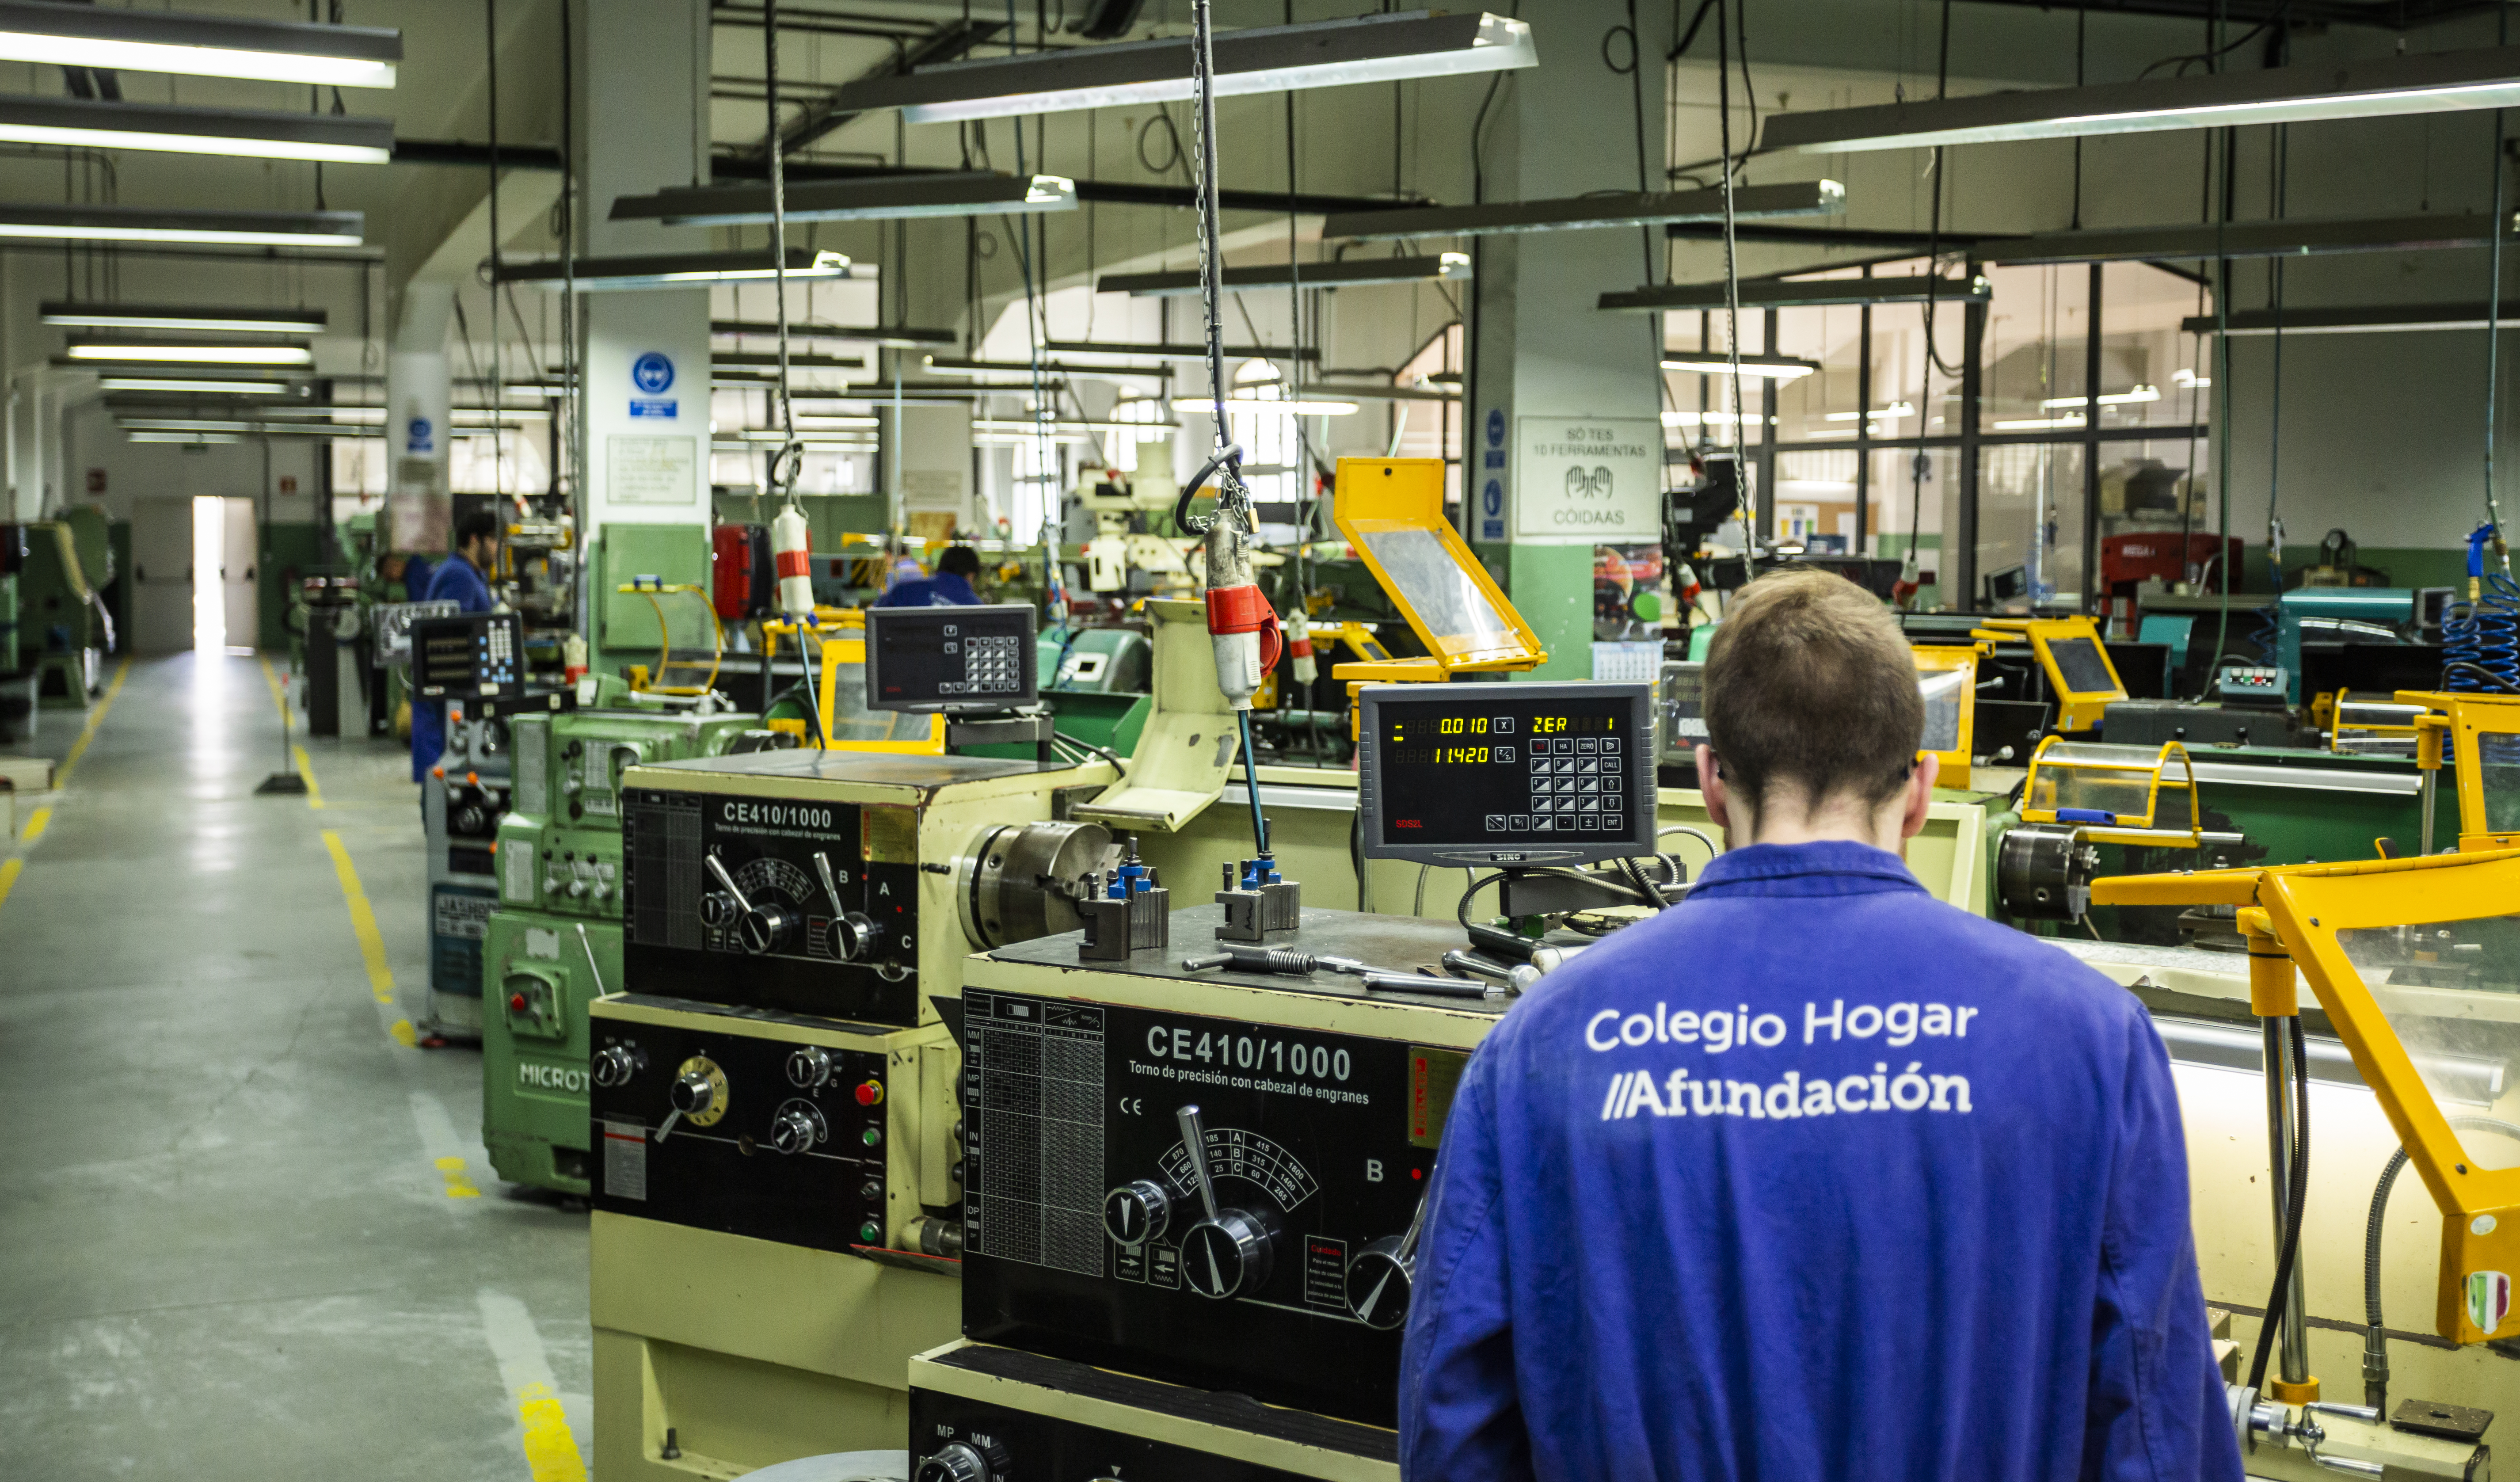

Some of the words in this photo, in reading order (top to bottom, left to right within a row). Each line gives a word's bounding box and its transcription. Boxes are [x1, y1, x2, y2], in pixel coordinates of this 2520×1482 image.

[1591, 428, 1614, 441] TES
[1534, 445, 1547, 456] 10
[1550, 444, 1647, 457] FERRAMENTAS
[1533, 717, 1567, 733] ZER
[1608, 717, 1613, 730] 1
[724, 801, 832, 829] CE410/1000
[839, 870, 849, 884] B
[879, 882, 890, 896] A
[902, 935, 912, 949] C
[1585, 1001, 1787, 1053] Colegio
[1804, 999, 1978, 1047] Hogar
[967, 1030, 980, 1040] MM
[1147, 1026, 1351, 1081] CE410/1000
[967, 1074, 980, 1082] MP
[1129, 1060, 1160, 1077] Torno
[1162, 1065, 1176, 1079] de
[1177, 1067, 1229, 1088] precisión
[1231, 1076, 1252, 1089] con
[1254, 1077, 1297, 1094] cabezal
[1299, 1083, 1313, 1097] de
[1315, 1088, 1370, 1106] engranes
[1119, 1097, 1142, 1116] CE
[969, 1132, 978, 1142] IN
[1205, 1134, 1219, 1143] 185
[1233, 1132, 1242, 1143] A
[1256, 1140, 1270, 1152] 415
[1172, 1147, 1184, 1161] 870
[1209, 1149, 1222, 1158] 140
[1233, 1147, 1241, 1158] B
[1251, 1154, 1266, 1166] 315
[1179, 1161, 1192, 1173] 660
[1214, 1163, 1224, 1173] 25
[1233, 1162, 1241, 1173] C
[1250, 1169, 1261, 1180] 60
[1288, 1161, 1305, 1181] 1800
[1367, 1159, 1384, 1183] B
[1187, 1174, 1199, 1186] 125
[1280, 1172, 1296, 1191] 1400
[1274, 1186, 1288, 1202] 265
[967, 1206, 980, 1215] DP
[1311, 1245, 1341, 1256] Cuidado
[937, 1424, 955, 1438] MP
[972, 1432, 991, 1448] MM
[992, 1474, 1005, 1482] IN
